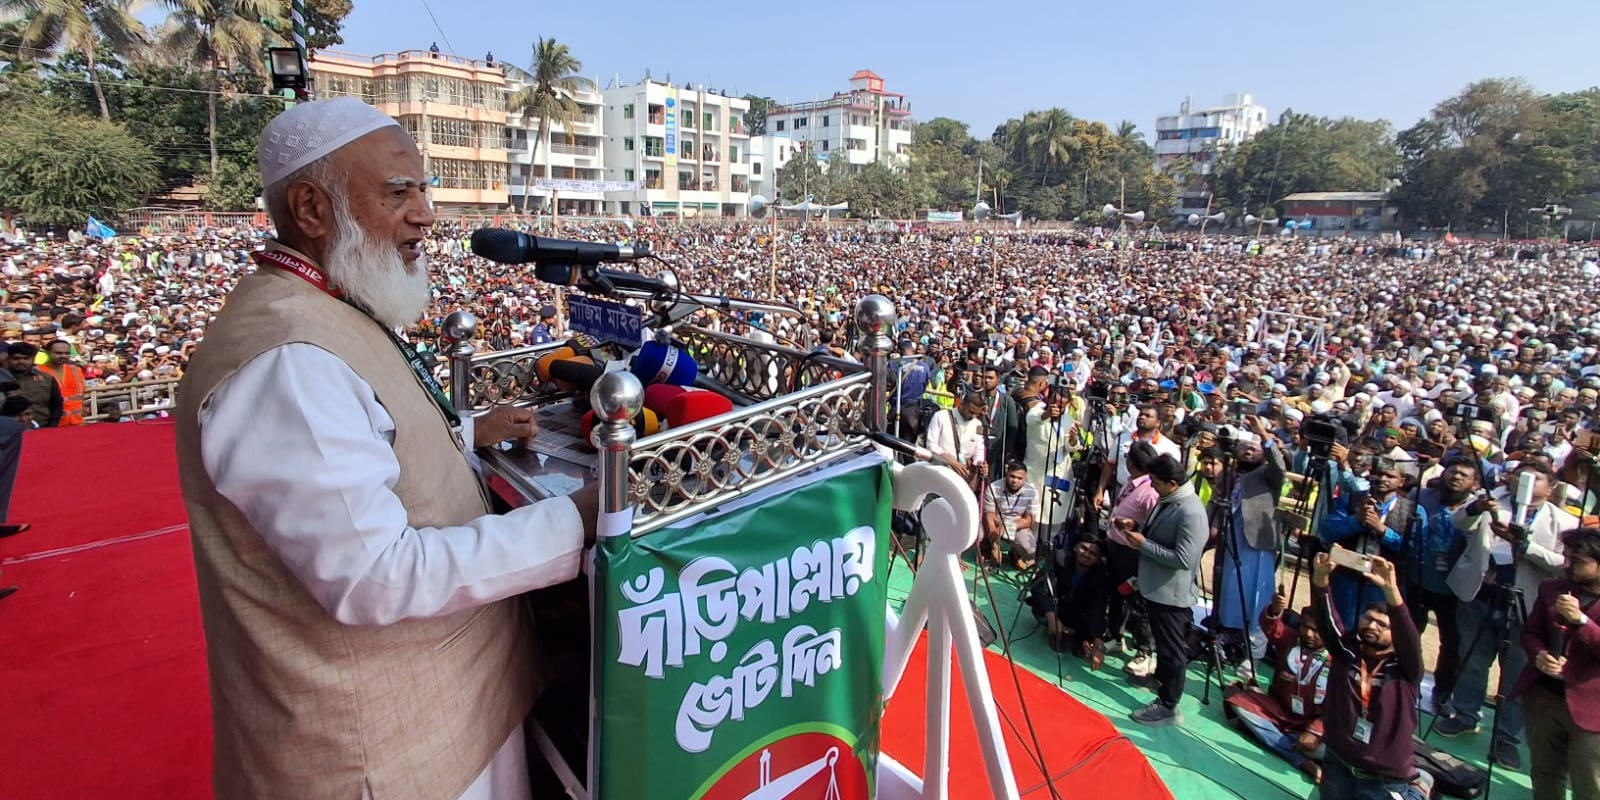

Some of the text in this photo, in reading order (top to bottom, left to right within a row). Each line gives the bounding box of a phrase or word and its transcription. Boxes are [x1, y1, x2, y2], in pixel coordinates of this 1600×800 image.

[264, 251, 322, 283] বাংলাদে
[606, 307, 640, 334] মাইক
[617, 526, 875, 679] দাঁড়িপাল্লায়
[675, 625, 841, 753] ভোট দিন
